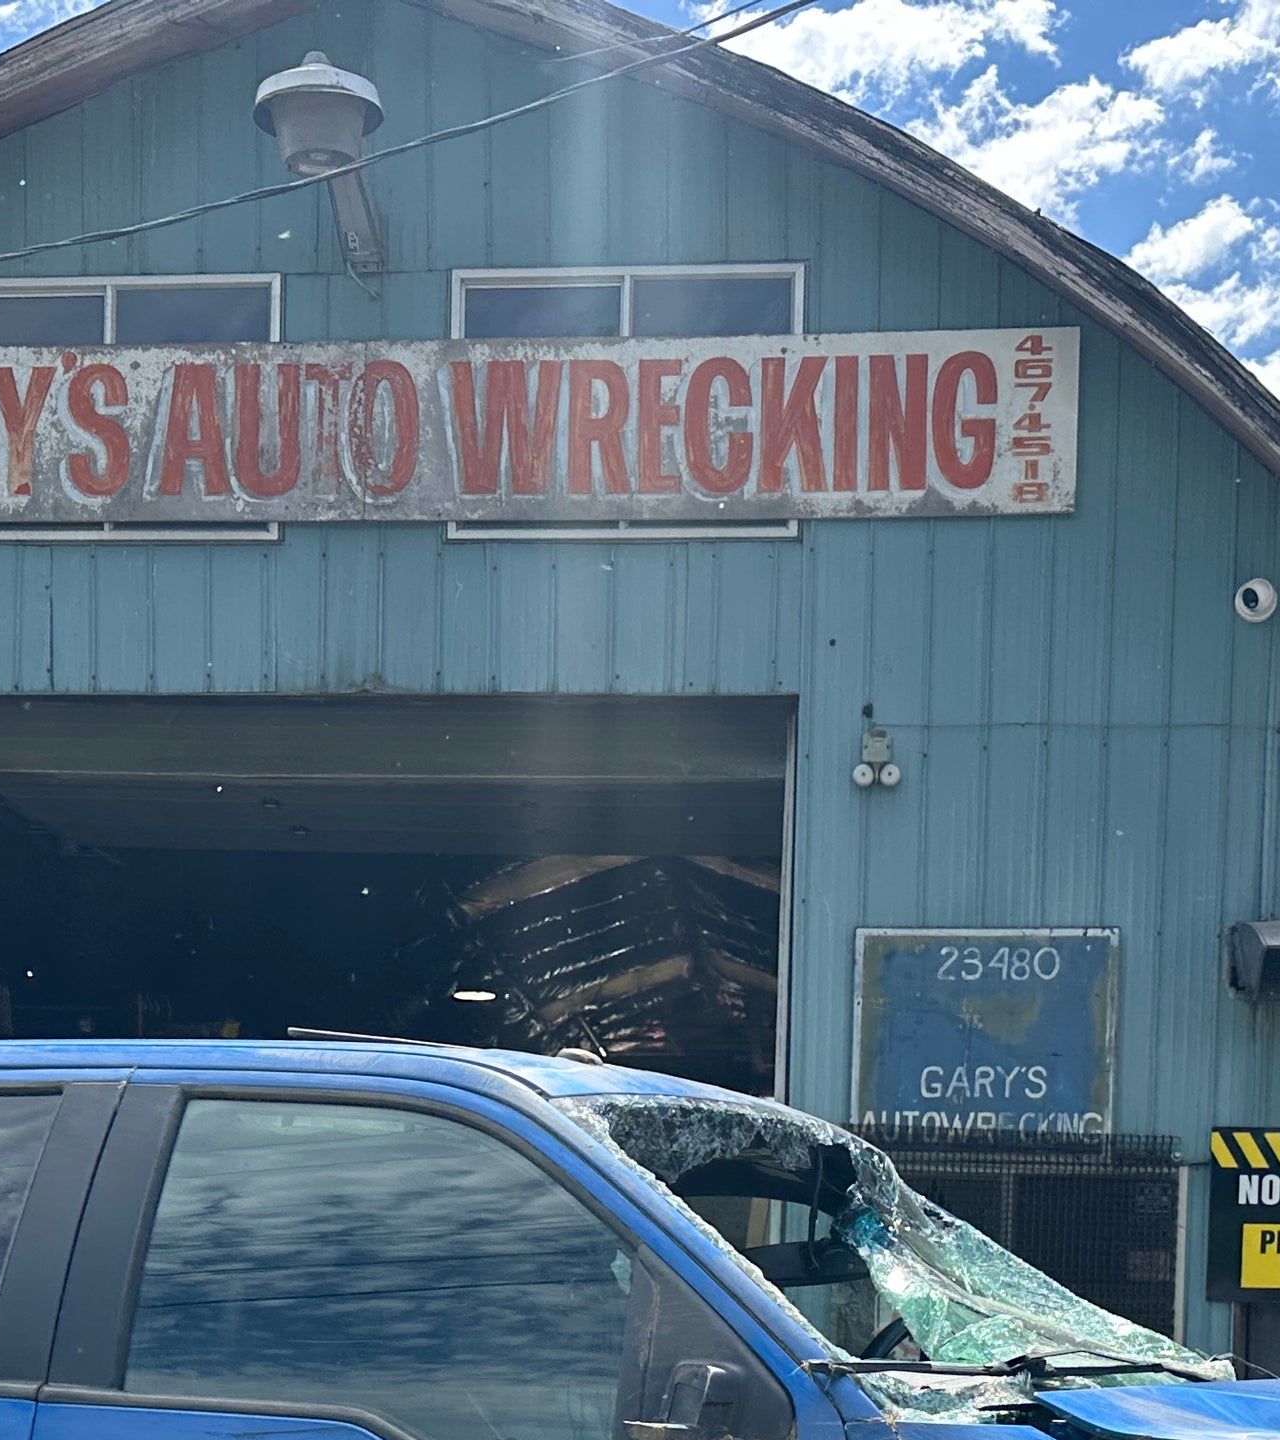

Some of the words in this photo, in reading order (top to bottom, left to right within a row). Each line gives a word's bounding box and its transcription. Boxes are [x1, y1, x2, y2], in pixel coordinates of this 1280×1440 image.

[157, 358, 420, 498] AUTO
[448, 349, 999, 497] WRECKING
[936, 946, 1061, 981] 23480
[920, 1066, 1048, 1099] GARY'S
[1238, 1174, 1280, 1206] NO
